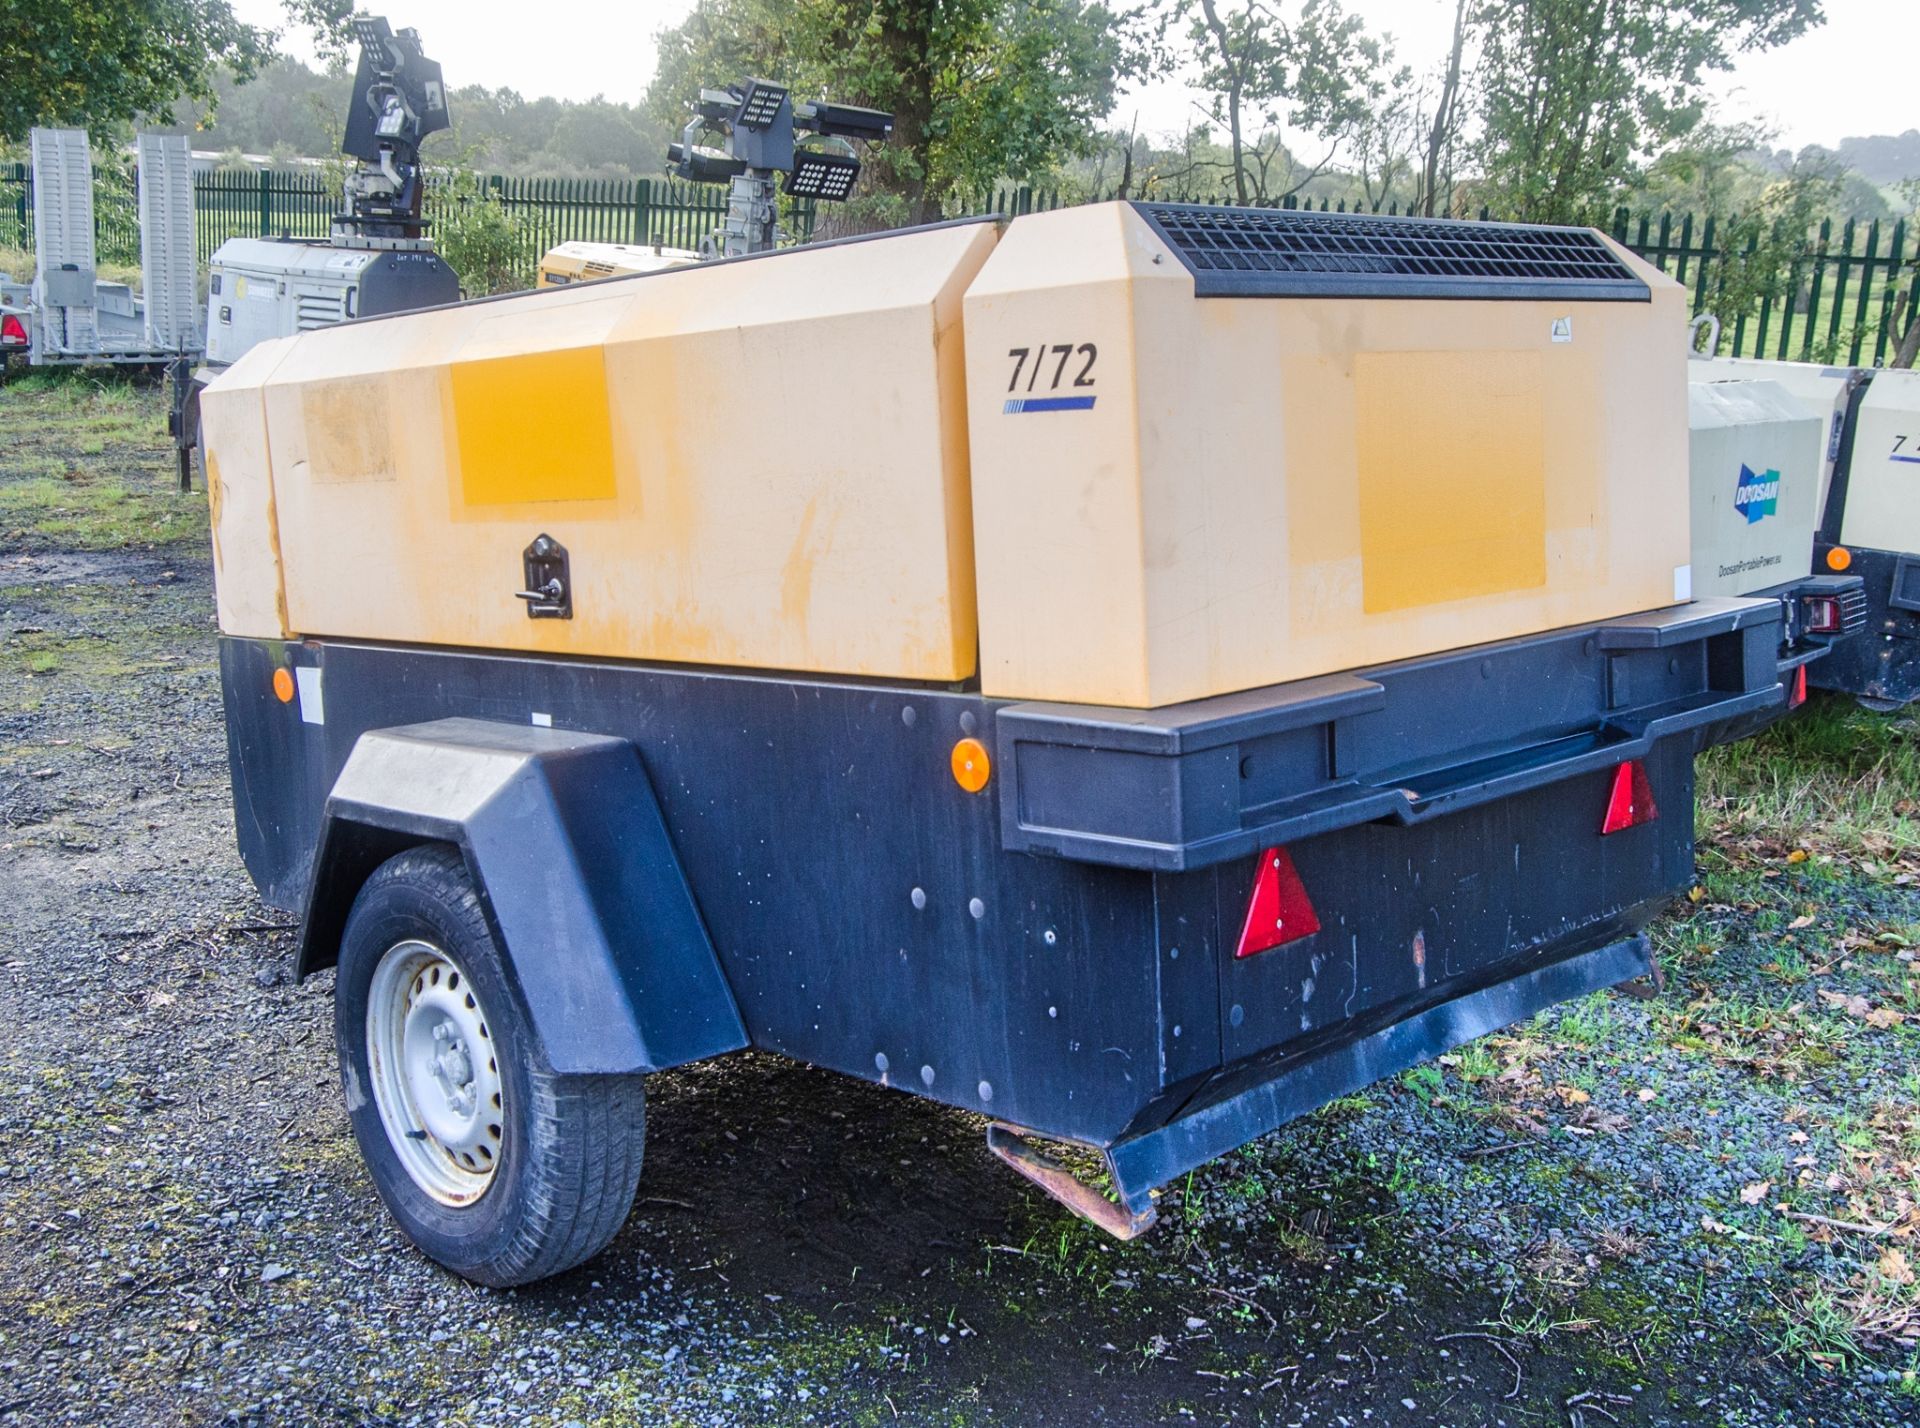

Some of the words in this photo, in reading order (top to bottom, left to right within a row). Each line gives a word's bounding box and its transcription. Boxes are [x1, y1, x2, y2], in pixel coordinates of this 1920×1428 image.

[1007, 342, 1098, 393] 7/72
[1735, 480, 1779, 506] DOOSAN
[1718, 554, 1782, 578] DoosanPortablePower.eu
